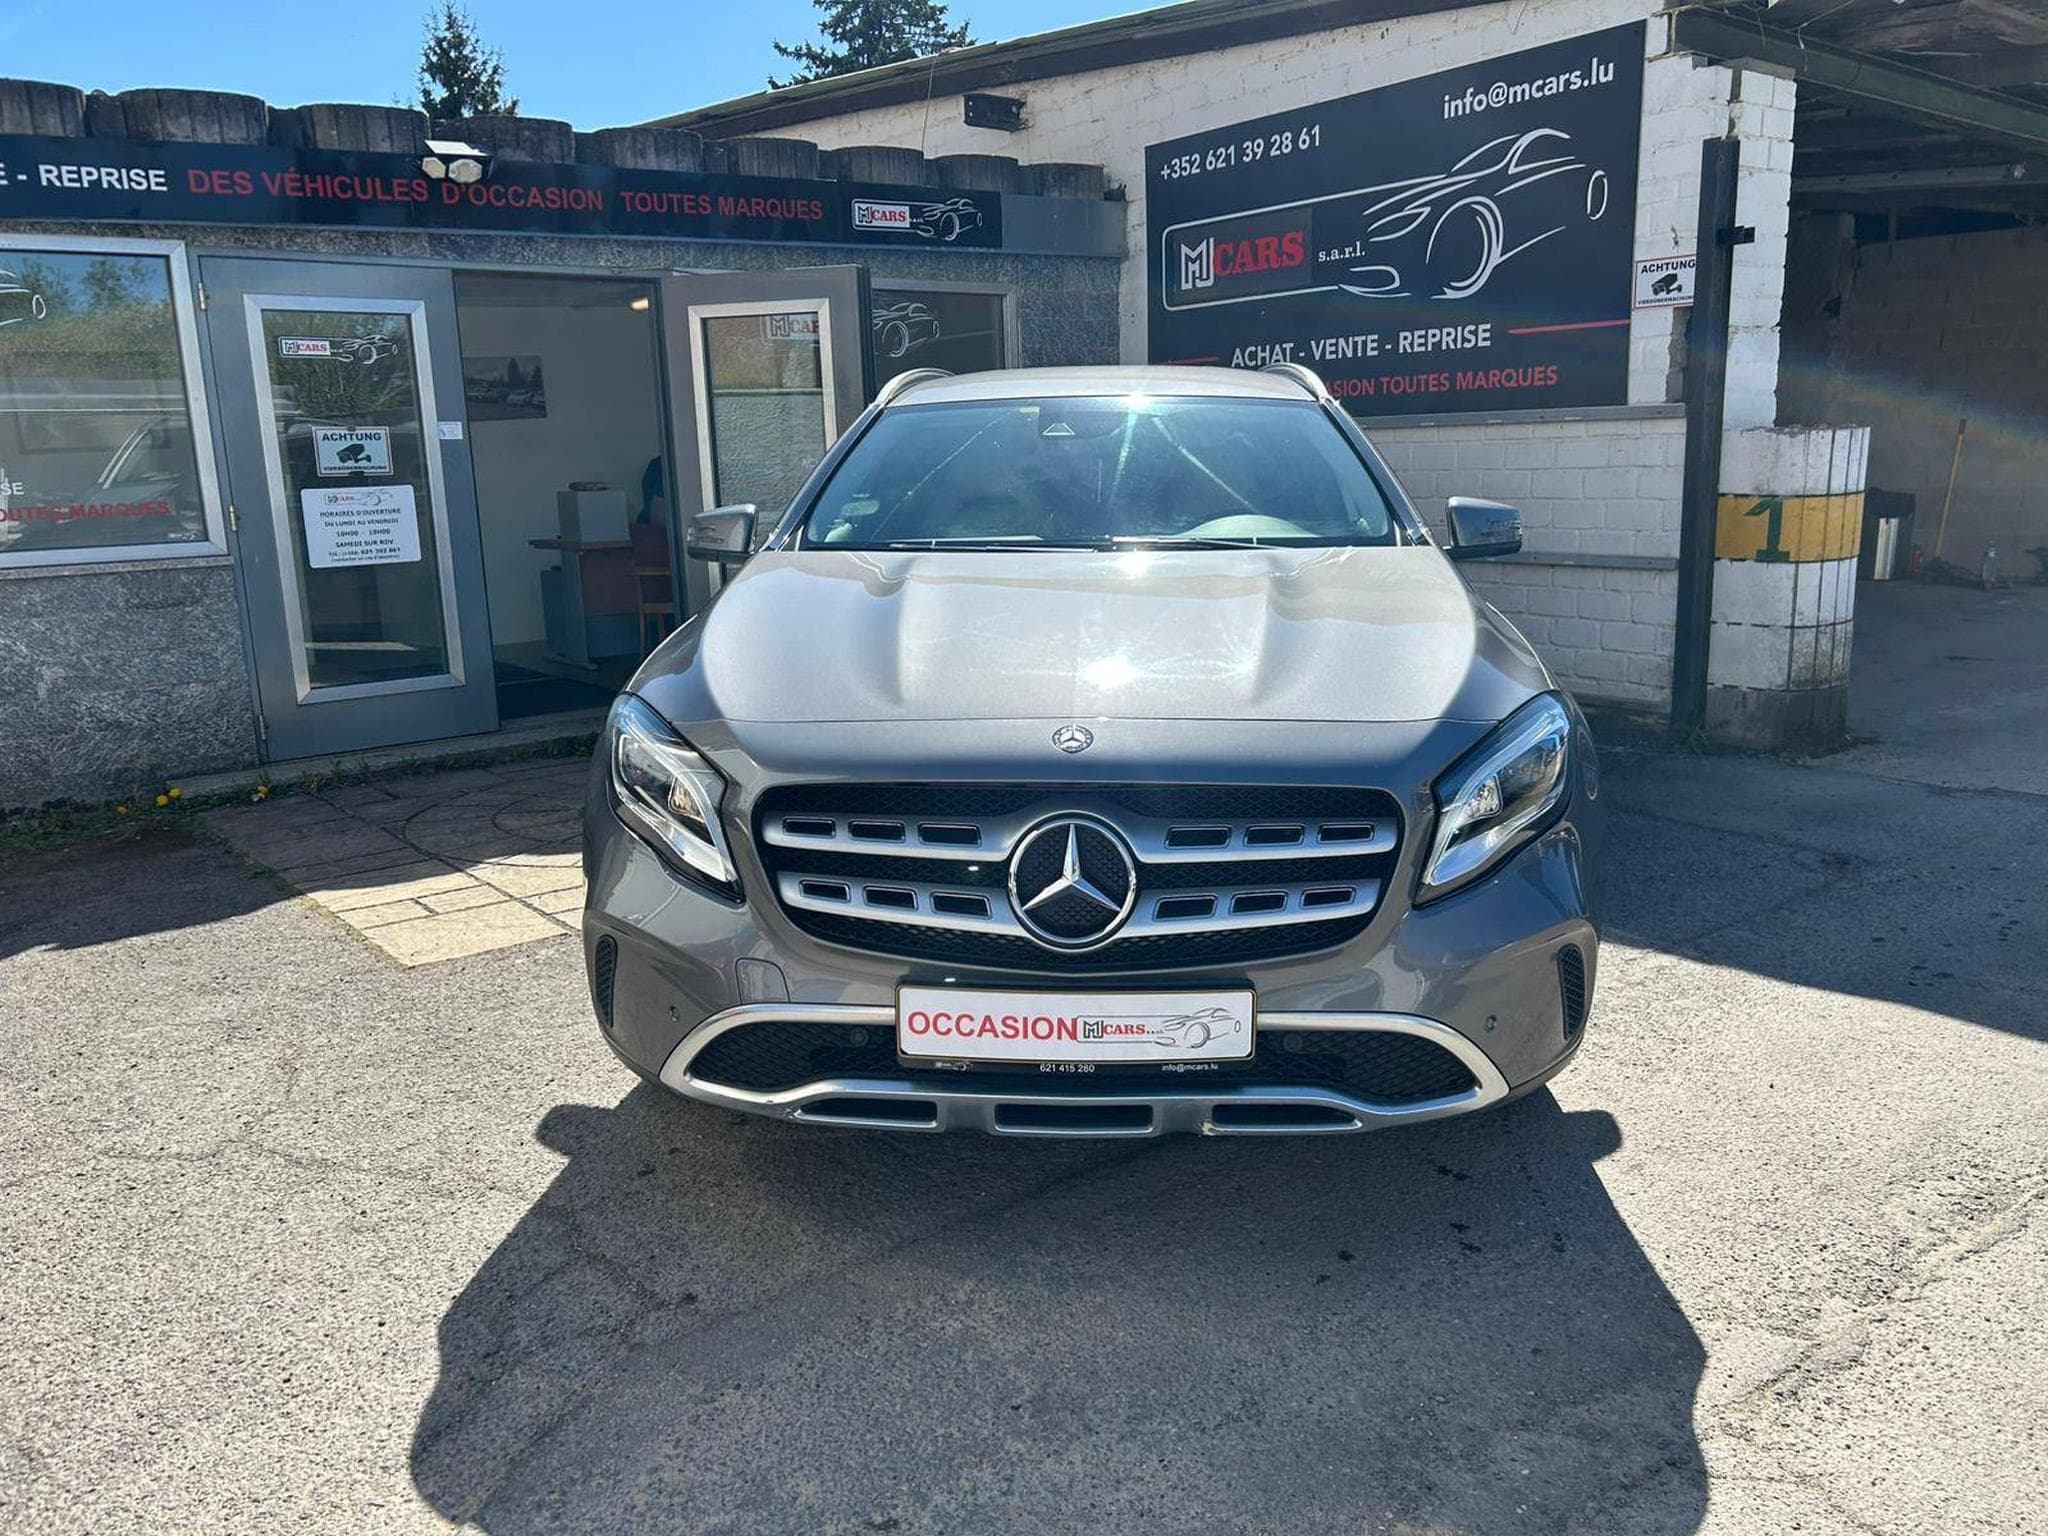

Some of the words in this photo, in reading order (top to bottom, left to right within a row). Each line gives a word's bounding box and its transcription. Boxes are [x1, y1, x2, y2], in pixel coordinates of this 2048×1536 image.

[1443, 57, 1615, 119] info@mcars.lu
[1161, 153, 1201, 180] +352
[1206, 145, 1236, 171] 621
[1242, 138, 1265, 163] 39
[1270, 131, 1293, 157] 28
[1298, 124, 1321, 150] 61
[38, 163, 168, 192] REPRISE
[187, 169, 254, 195] DES
[261, 167, 429, 202] VÉHICULES
[620, 191, 712, 215] TOUTES
[718, 196, 823, 220] MARQUES
[1640, 259, 1696, 274] ACHTUNG
[1231, 342, 1294, 367] ACHAT
[1311, 334, 1379, 361] VENTE
[1398, 323, 1492, 354] REPRISE
[1382, 372, 1449, 395] TOUTES
[1456, 365, 1559, 391] MARQUES
[322, 432, 382, 442] ACHTUNG
[69, 499, 171, 518] MARQUES
[1743, 497, 1791, 563] 1
[907, 1010, 1079, 1042] OCCASION
